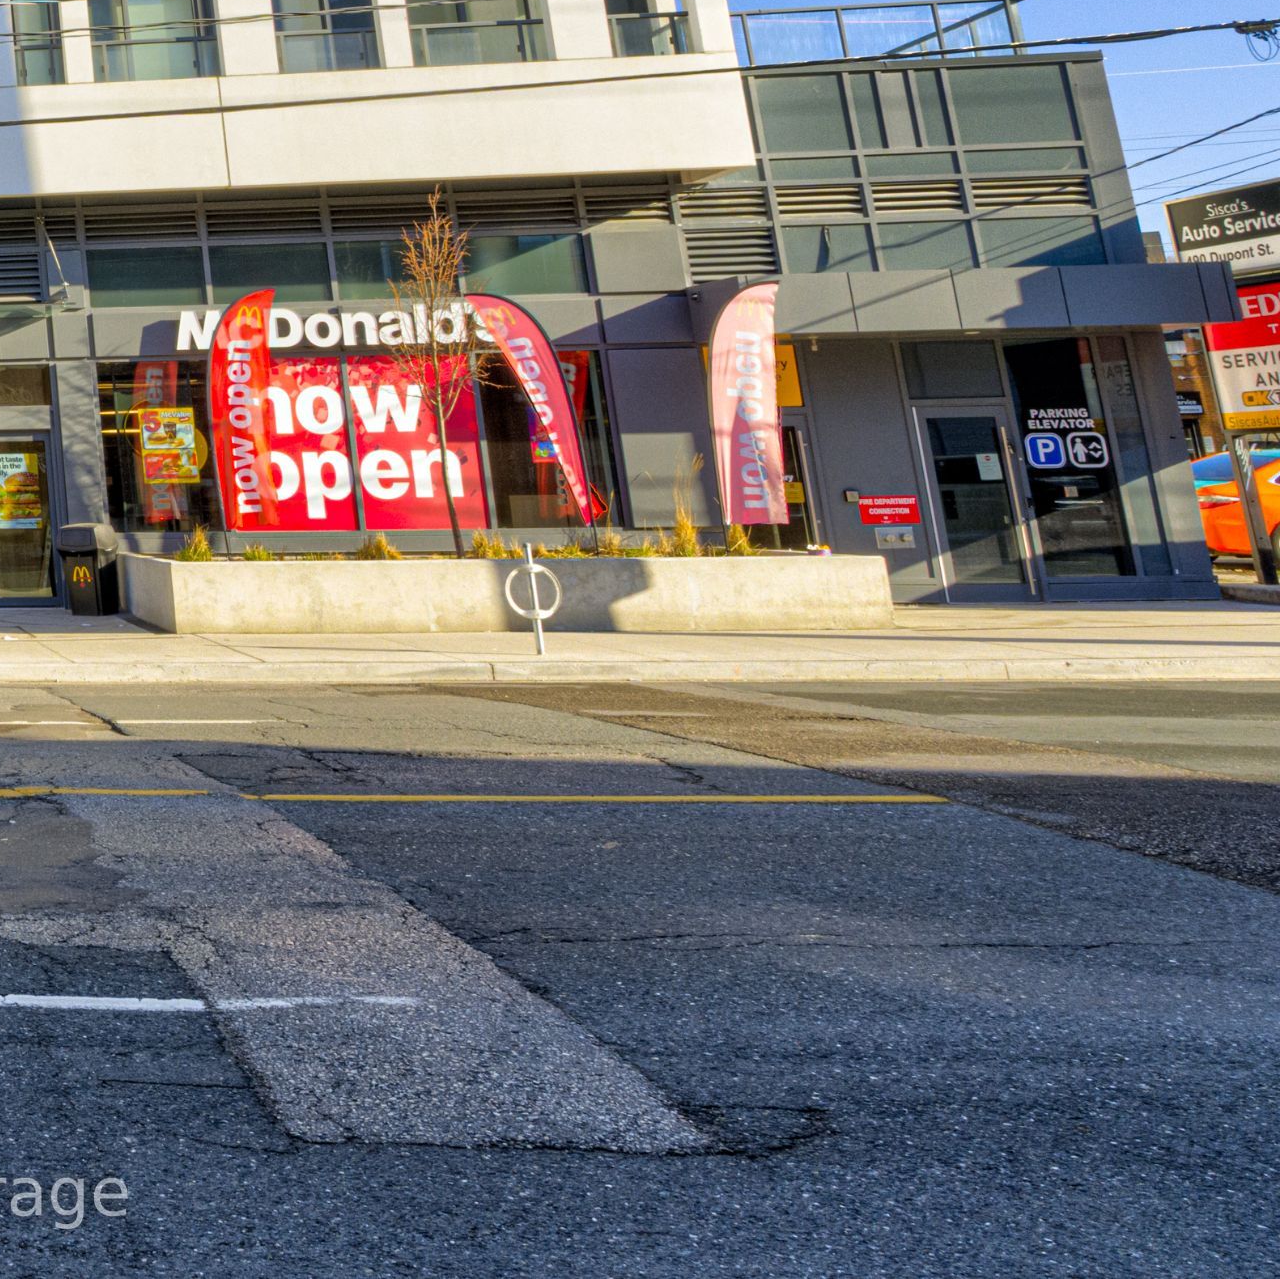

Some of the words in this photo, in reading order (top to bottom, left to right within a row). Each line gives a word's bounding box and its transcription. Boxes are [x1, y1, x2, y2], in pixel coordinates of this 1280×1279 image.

[1205, 198, 1249, 217] Sisca's
[1181, 224, 1221, 243] Auto
[1209, 247, 1255, 263] Dupont
[1257, 243, 1275, 257] St.
[1222, 350, 1280, 369] SERVI
[226, 338, 259, 429] open
[255, 384, 423, 434] now
[1029, 407, 1089, 419] PARKING
[1027, 418, 1096, 429] ELEVATOR
[232, 436, 262, 514] now
[874, 497, 916, 505] DEPARTMENT
